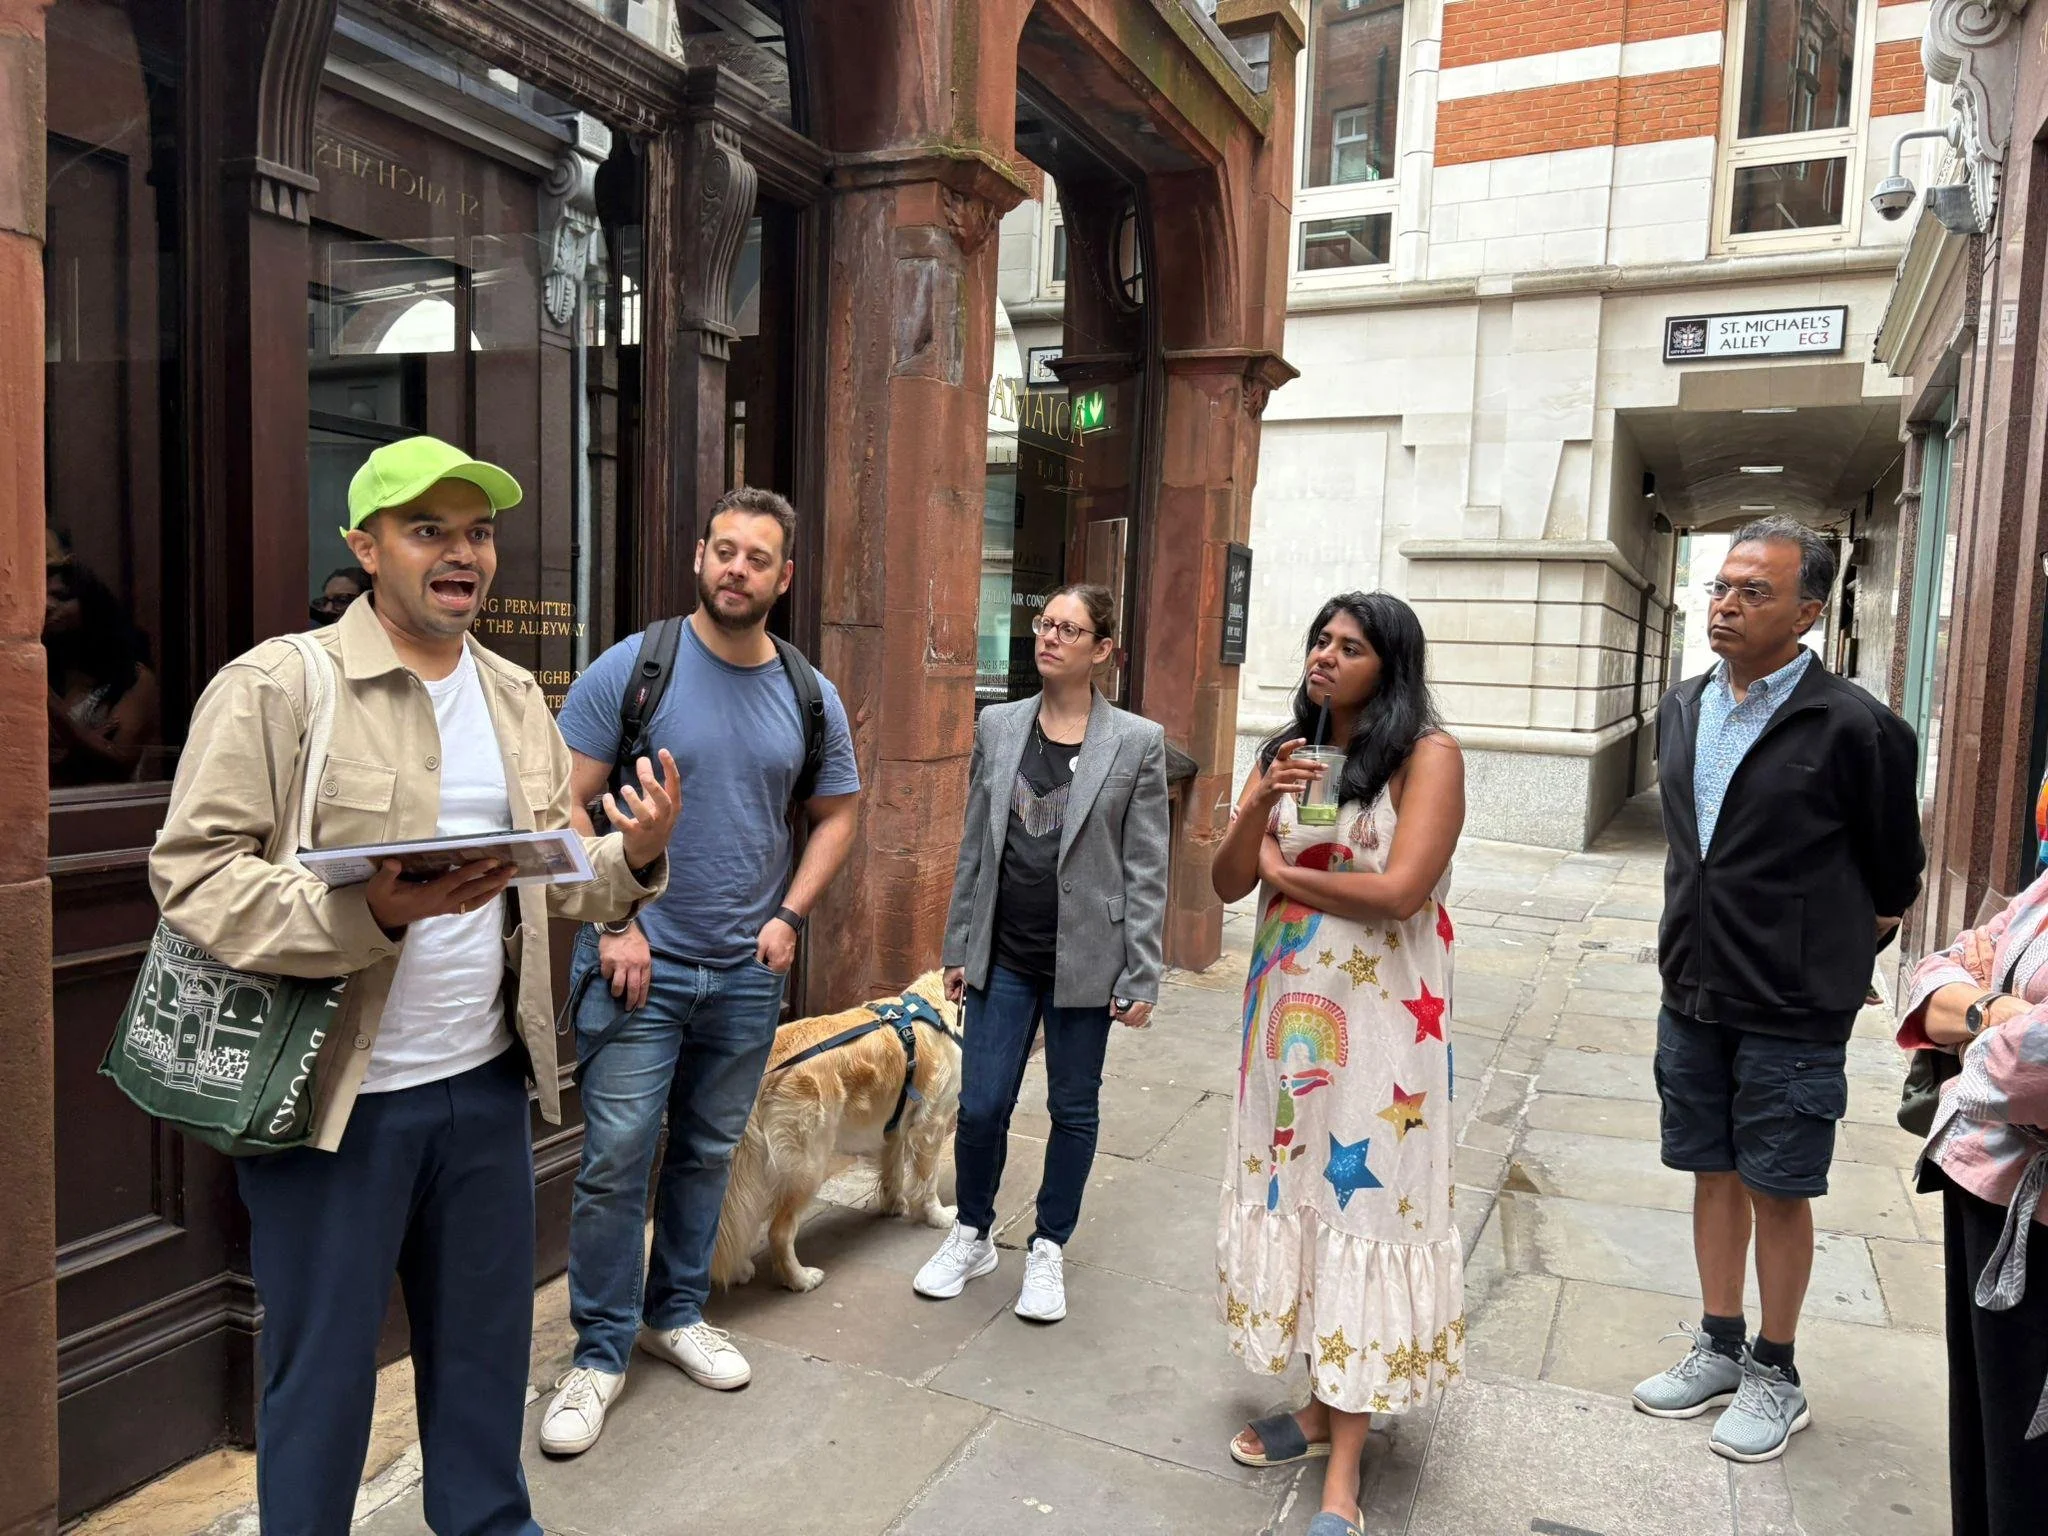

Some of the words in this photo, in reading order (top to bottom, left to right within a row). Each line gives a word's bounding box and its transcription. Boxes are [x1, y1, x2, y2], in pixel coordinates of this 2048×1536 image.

[1720, 321, 1741, 335] ST.
[1745, 315, 1831, 333] MICHAEL'S
[1720, 335, 1770, 350] ALLEY
[1799, 332, 1829, 345] EC3
[505, 599, 576, 617] PERMITTED
[1011, 592, 1024, 606] AIR
[486, 619, 514, 633] THE
[519, 620, 586, 637] ALLEYWAY
